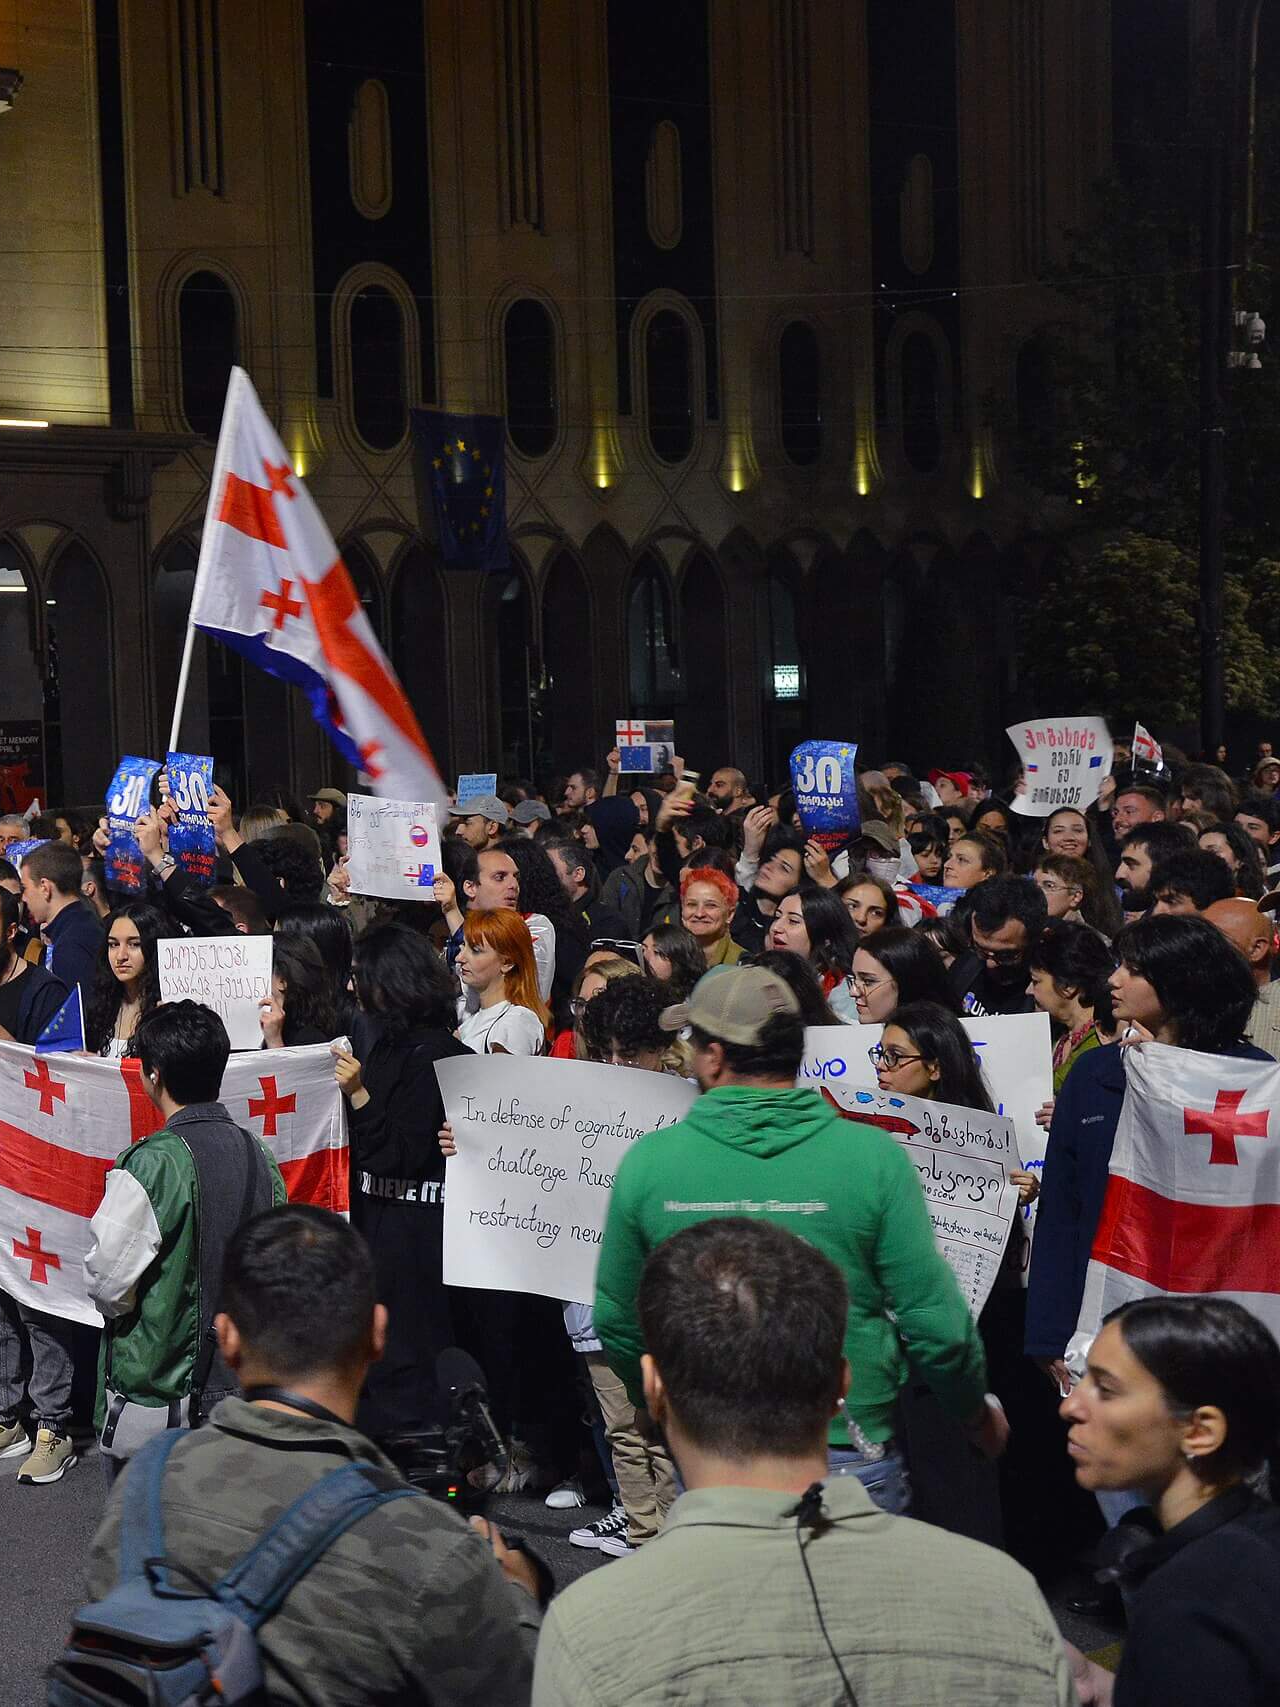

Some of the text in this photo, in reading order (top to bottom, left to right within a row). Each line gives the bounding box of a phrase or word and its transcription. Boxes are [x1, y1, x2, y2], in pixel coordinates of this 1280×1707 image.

[8, 737, 39, 745] MEMORY
[460, 1095, 486, 1123] In
[490, 1098, 545, 1130] defense
[550, 1105, 572, 1130] of
[574, 1111, 645, 1149] cognitive
[487, 1145, 568, 1193] challenge
[913, 1152, 1000, 1202] ოსკოვი
[469, 1199, 561, 1249] restricting
